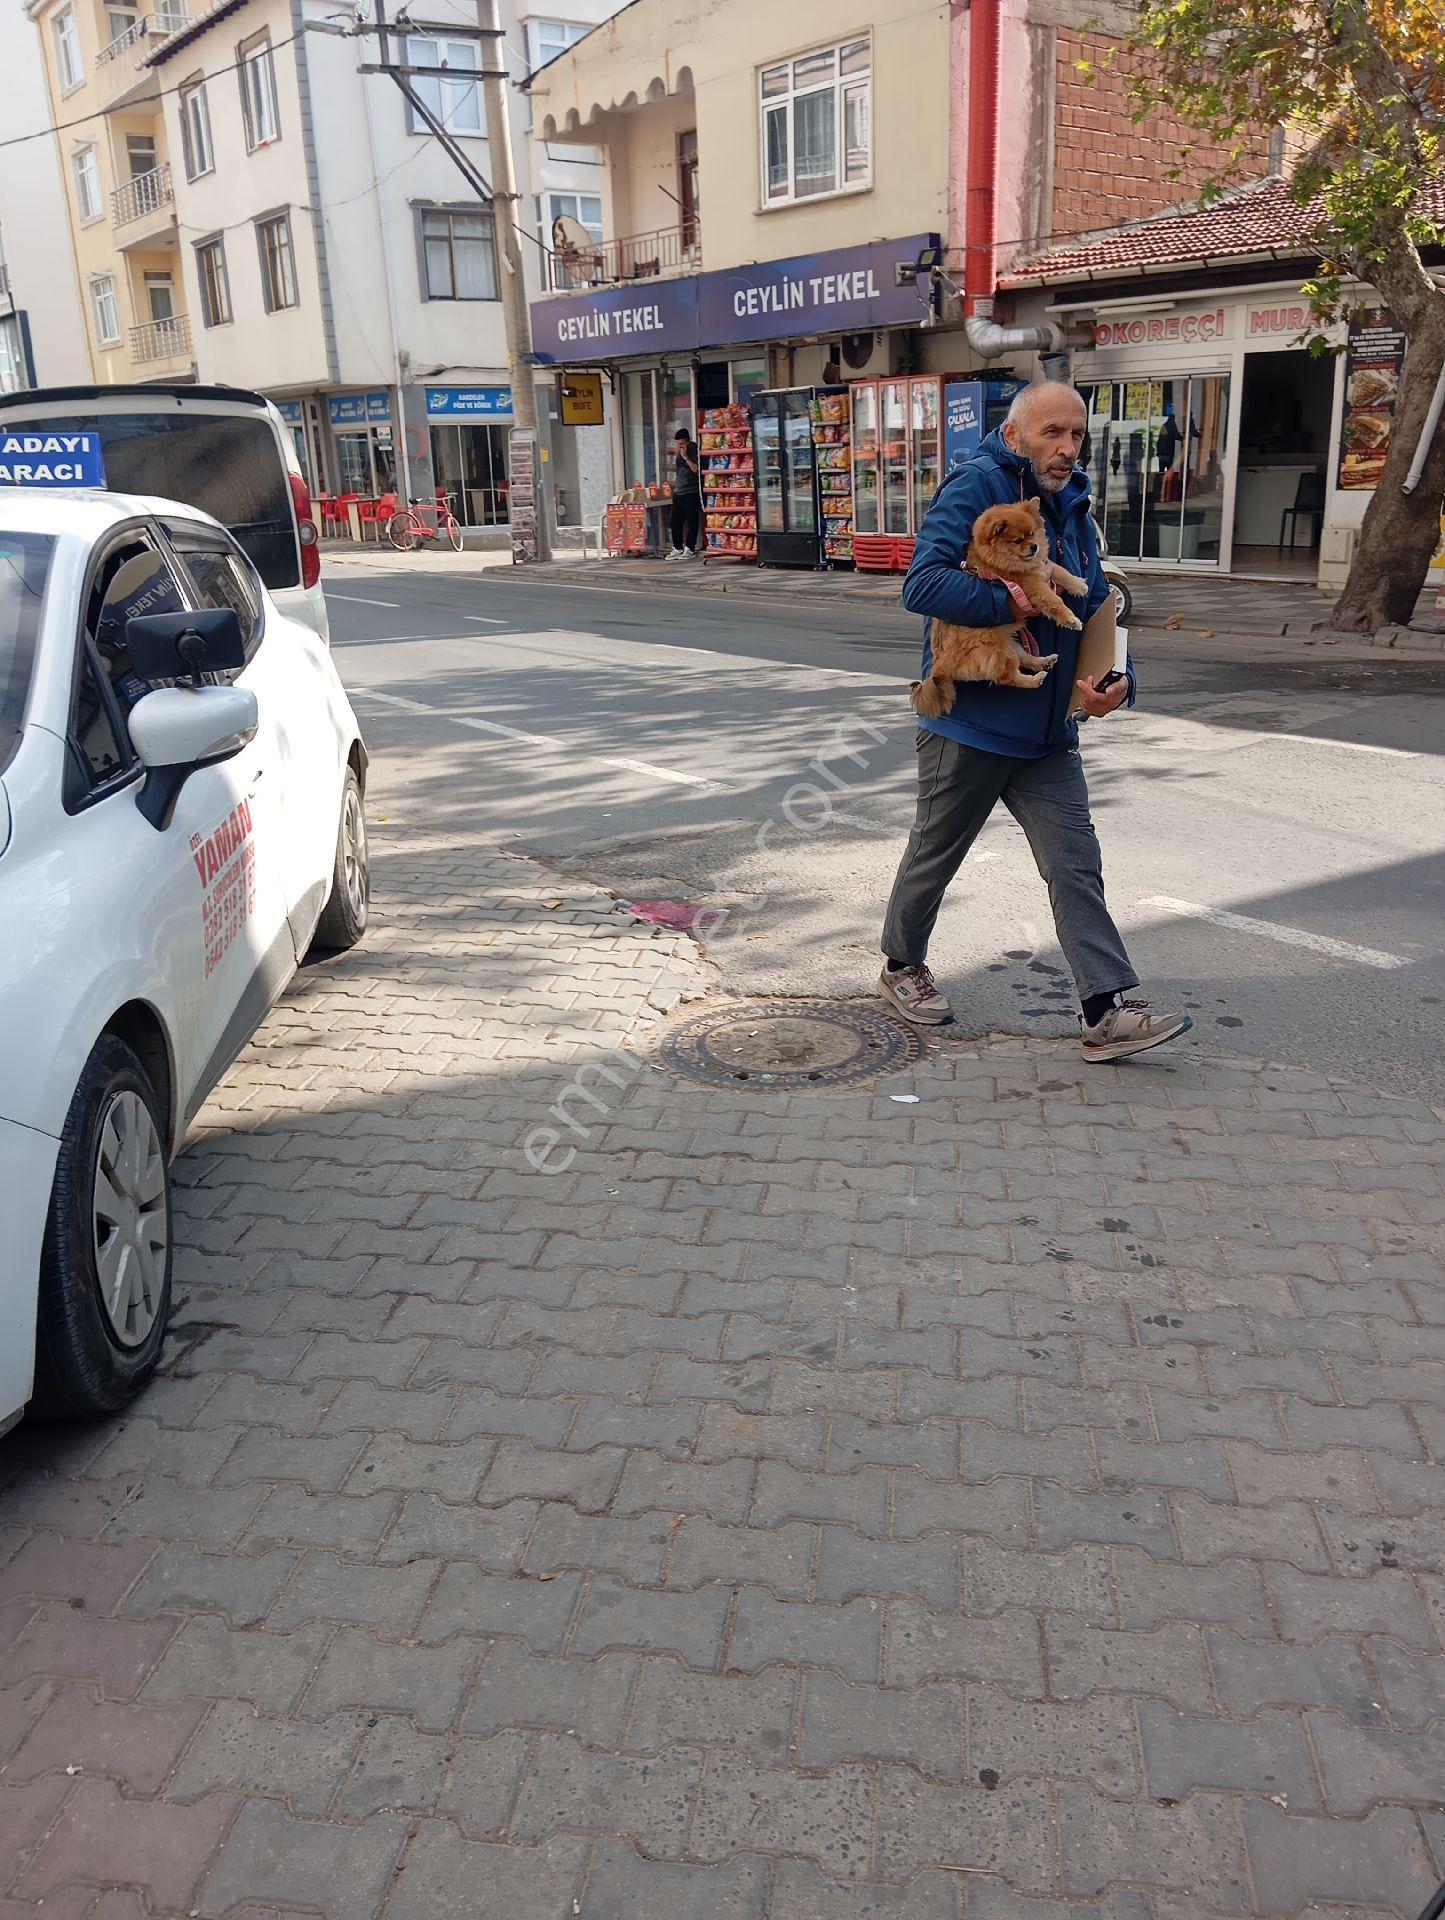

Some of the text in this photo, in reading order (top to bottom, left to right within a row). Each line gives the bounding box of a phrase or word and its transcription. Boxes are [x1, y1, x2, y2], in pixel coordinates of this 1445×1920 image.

[734, 270, 880, 317] CEYLİN TEKEL
[558, 305, 664, 342] CEYLİN TEKEL
[1090, 307, 1322, 345] OKOREÇÇİ MURA
[2, 437, 90, 453] ADAYI
[193, 798, 252, 890] YAMAN
